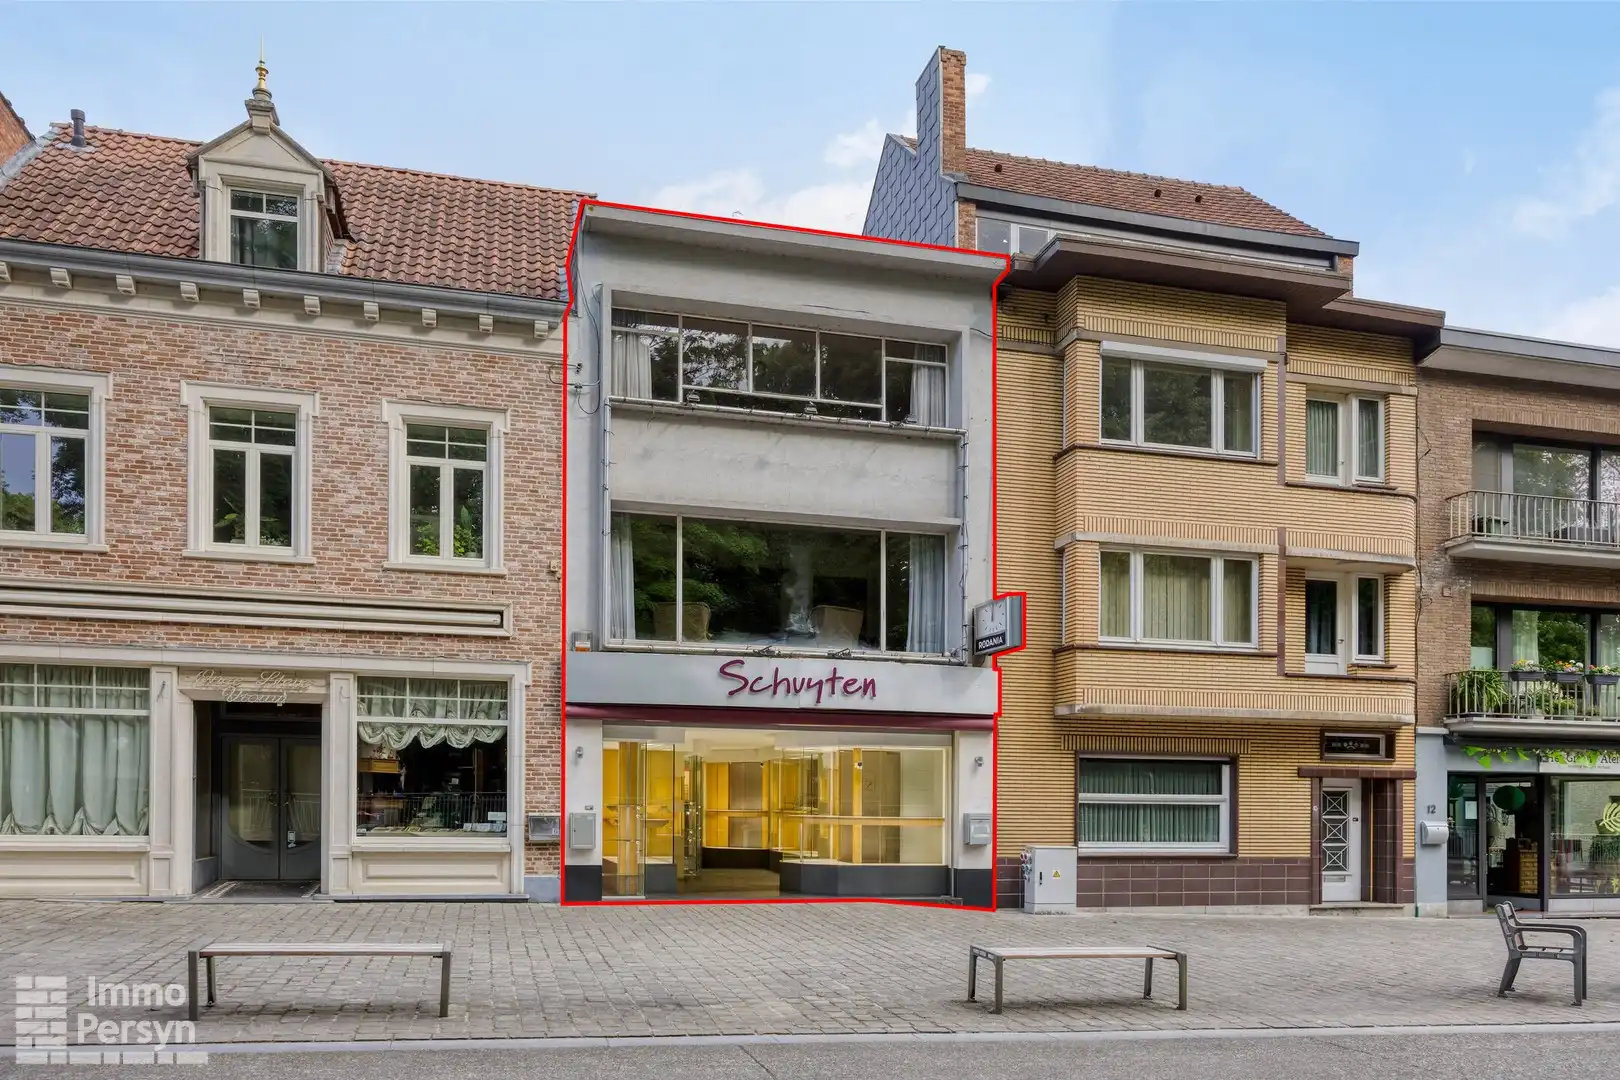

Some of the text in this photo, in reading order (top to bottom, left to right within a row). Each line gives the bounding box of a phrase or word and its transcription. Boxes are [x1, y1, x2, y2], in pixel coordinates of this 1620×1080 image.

[978, 636, 1004, 650] RODANIA
[719, 659, 877, 704] Schuyten
[1426, 804, 1437, 815] 12
